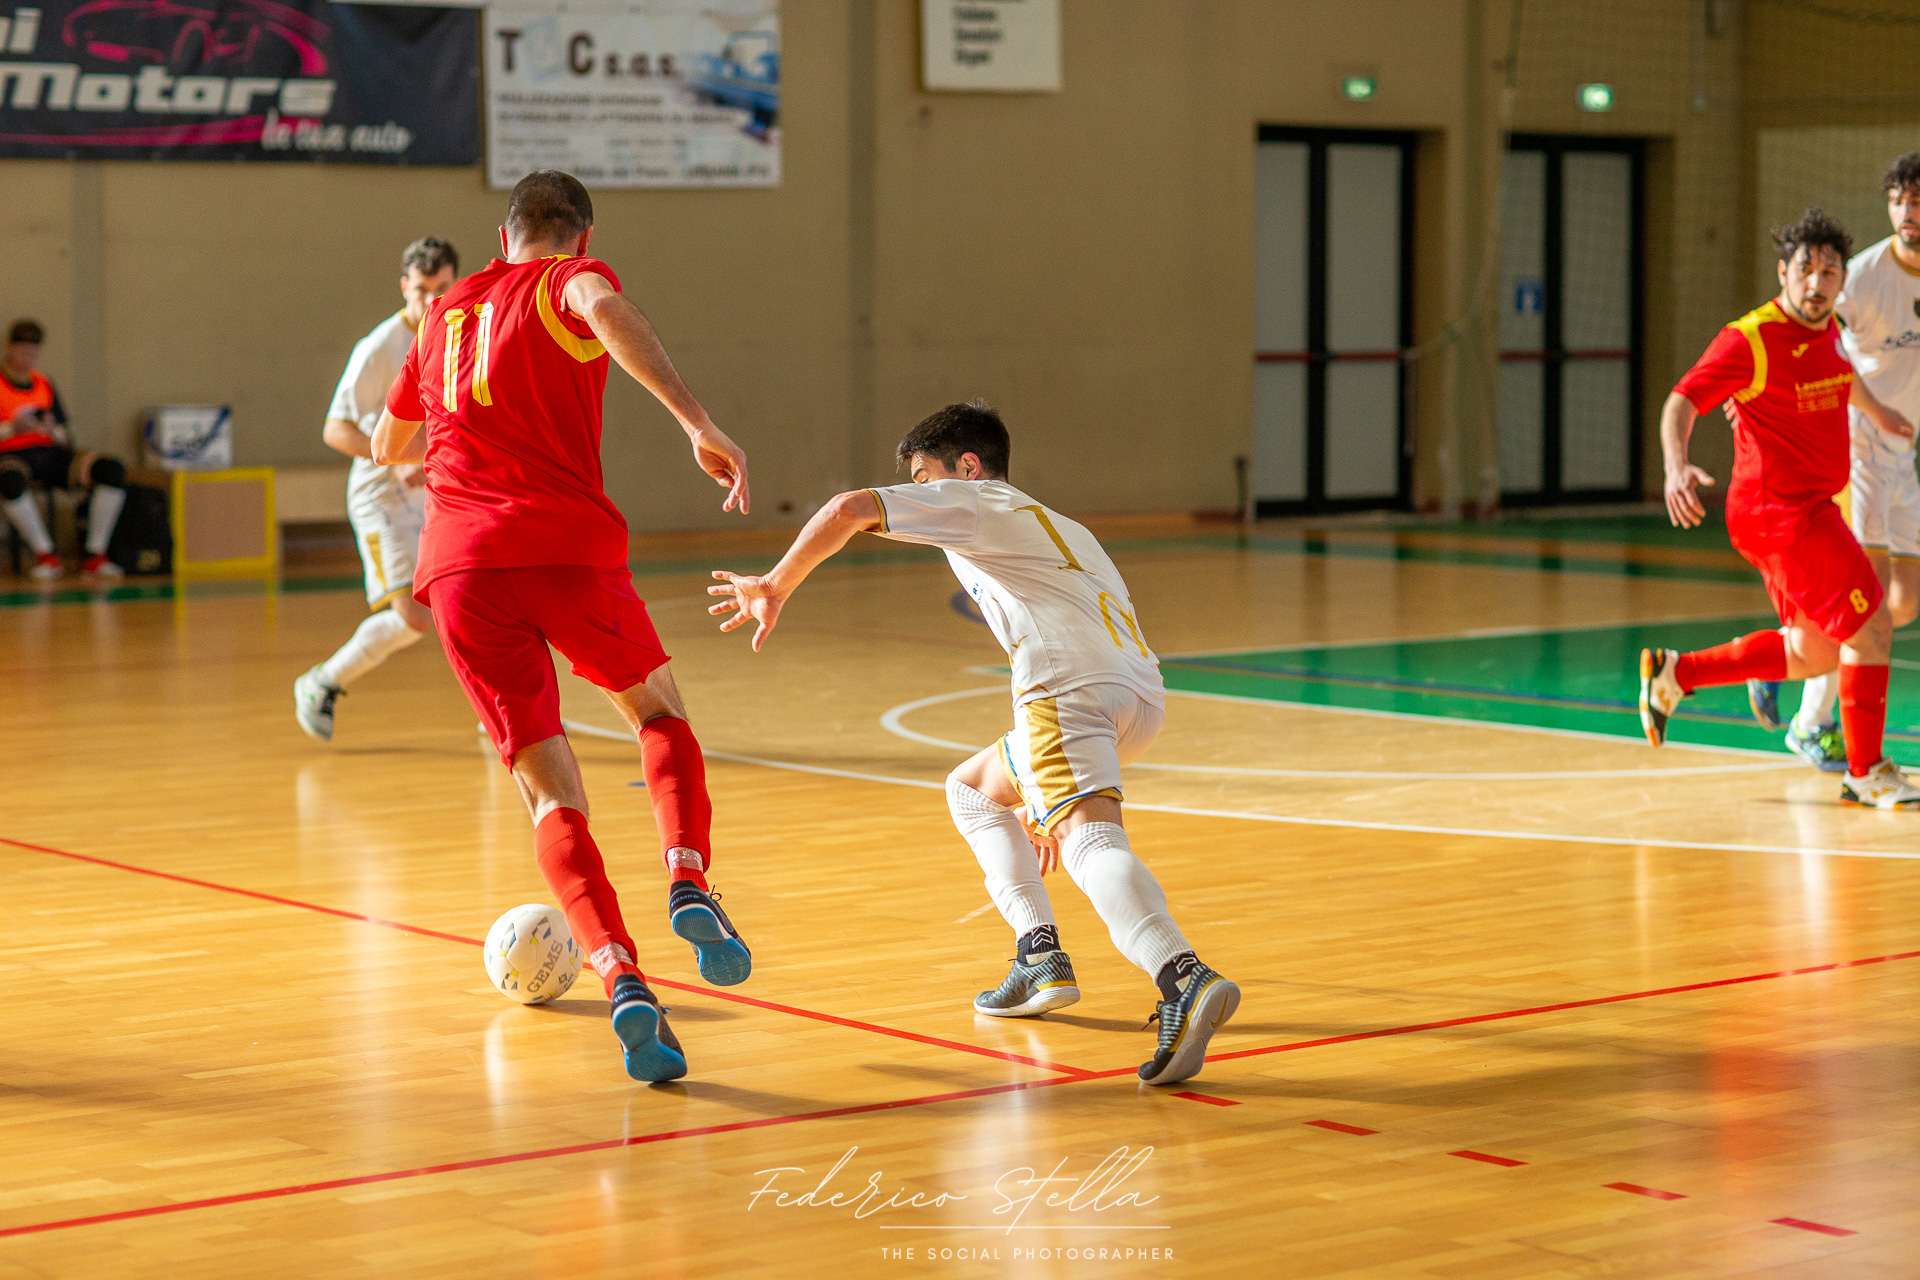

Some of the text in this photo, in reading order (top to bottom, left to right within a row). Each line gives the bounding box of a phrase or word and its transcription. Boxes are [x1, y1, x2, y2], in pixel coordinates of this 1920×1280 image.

[0, 62, 336, 116] Motors
[443, 301, 493, 412] 11
[1849, 588, 1869, 614] 8
[526, 940, 564, 993] GEMS
